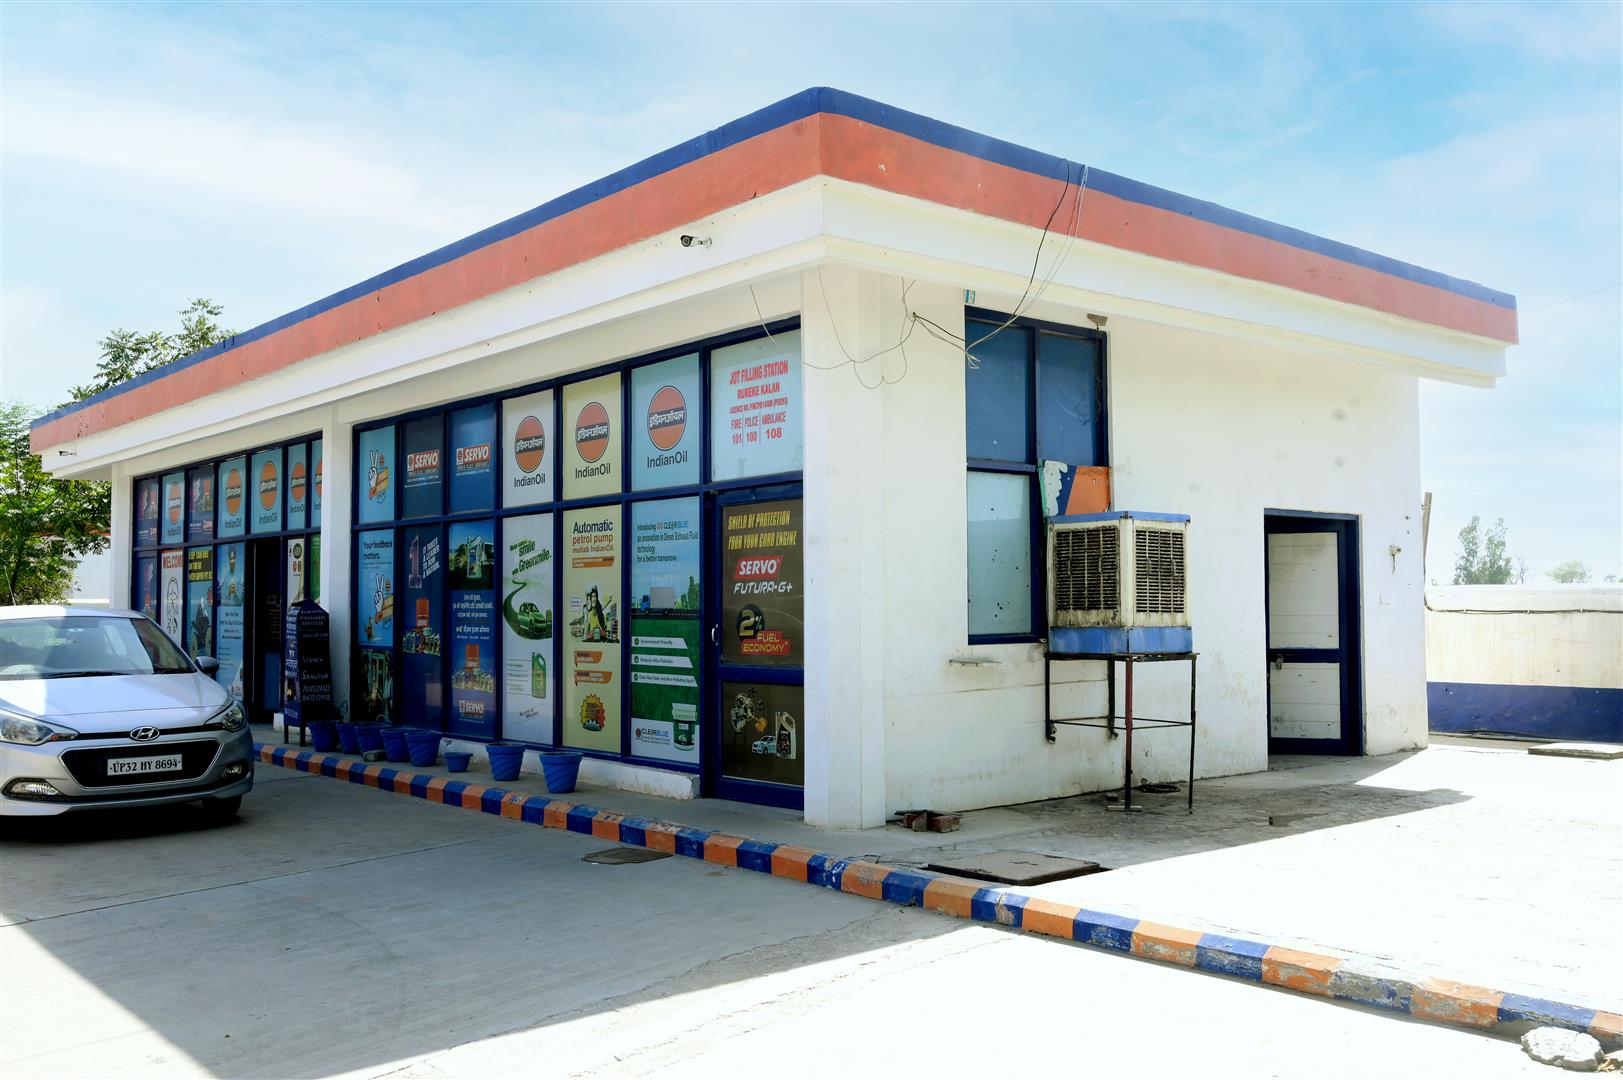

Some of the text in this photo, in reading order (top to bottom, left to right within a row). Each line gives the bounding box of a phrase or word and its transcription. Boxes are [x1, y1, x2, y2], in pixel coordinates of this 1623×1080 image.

[729, 360, 789, 385] JOT FILLING STATION
[737, 381, 780, 400] RUREKE KALAN
[731, 411, 786, 430] FIRE POLICE AMBULANCE
[732, 427, 782, 445] 101 100 108
[414, 452, 438, 469] SERVO
[464, 445, 489, 461] SERVO
[646, 450, 688, 469] IndianOil
[575, 462, 611, 479] IndianOil
[513, 473, 546, 488] IndianOil
[225, 518, 241, 529] IndianOil
[258, 513, 278, 525] IndianOil
[573, 519, 614, 534] Automatic
[728, 510, 790, 530] SHIELD OF PROTECTION
[572, 534, 613, 546] petrol pump
[743, 533, 758, 549] YOUR
[775, 530, 797, 546] ENGINE
[518, 540, 535, 557] smile
[739, 559, 777, 576] SERVO
[757, 631, 780, 642] FUEL
[464, 702, 484, 714] SERVO
[113, 758, 178, 773] UP32 HY 8694
